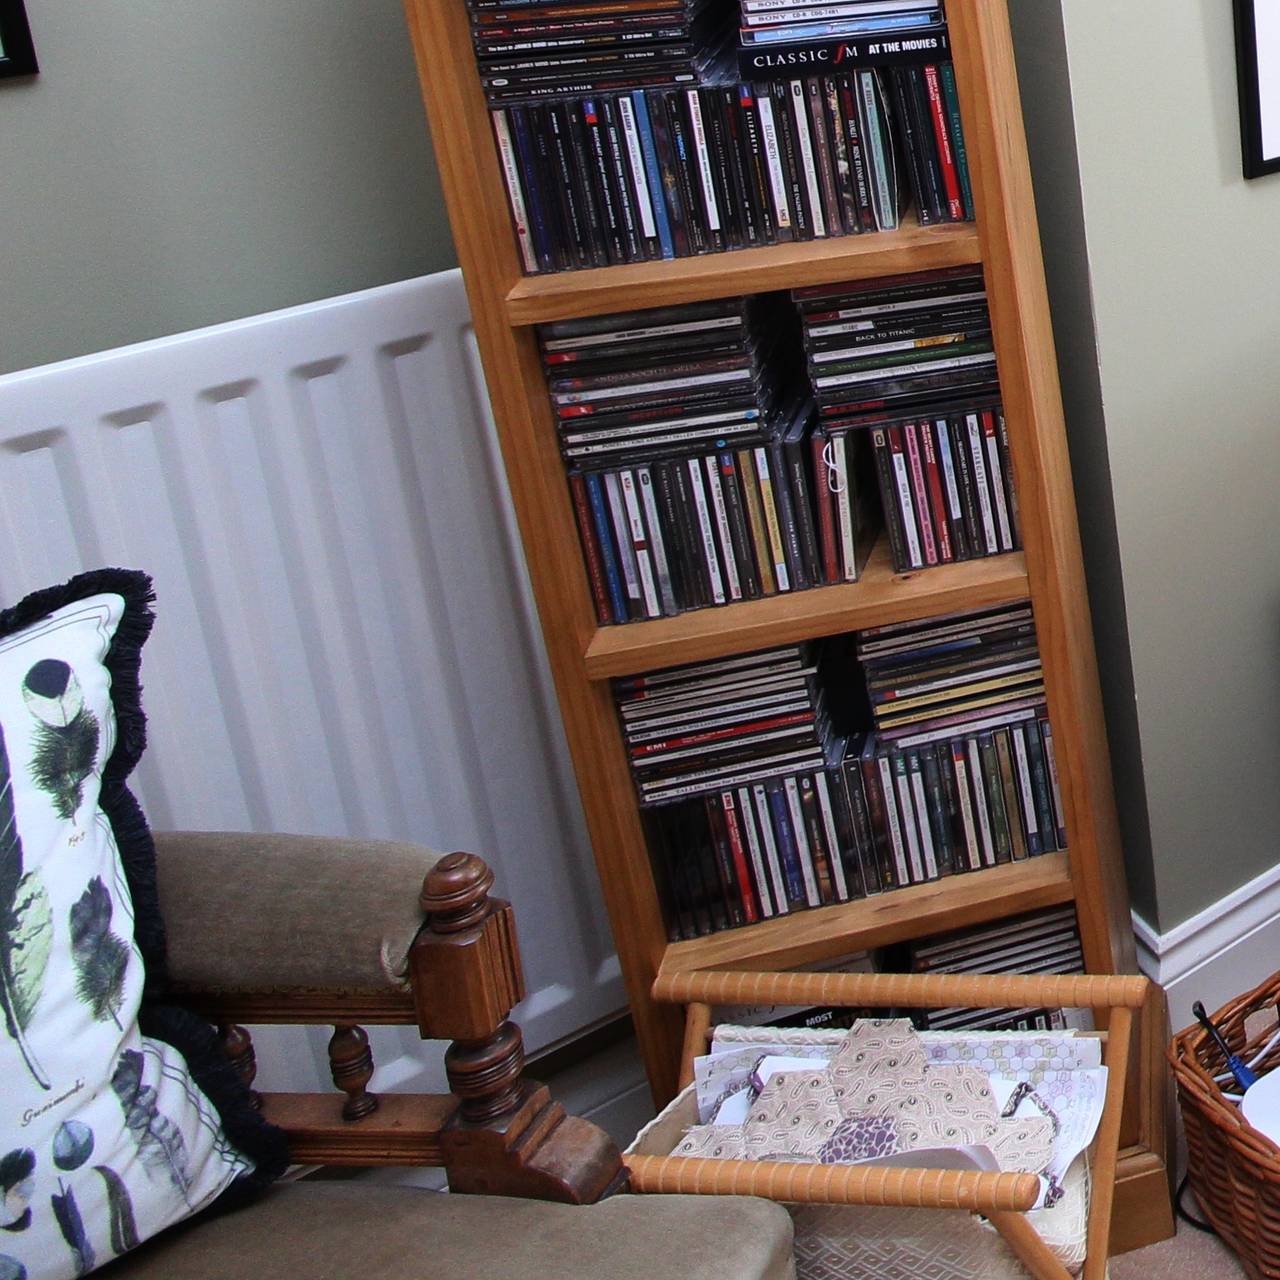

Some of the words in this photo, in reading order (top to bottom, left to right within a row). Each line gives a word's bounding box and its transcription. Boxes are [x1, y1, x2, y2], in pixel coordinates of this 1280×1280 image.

[752, 48, 828, 67] CLASSIC
[867, 43, 880, 54] AT
[882, 41, 901, 53] THE
[901, 37, 937, 51] MOVIES
[555, 84, 592, 92] ARTHUR
[621, 99, 629, 114] JOHN
[623, 114, 632, 130] BARRY
[848, 119, 857, 138] HAMLET
[591, 125, 602, 156] BRAVEHEART
[608, 126, 616, 143] CASINO
[746, 111, 758, 153] ELIZABETH
[765, 124, 776, 159] ELIZABETH
[852, 145, 860, 159] MUSIC
[597, 156, 605, 173] original
[600, 173, 608, 188] motion
[607, 204, 616, 228] soundtrack
[855, 333, 874, 341] BACK
[888, 328, 915, 337] TITANIC
[957, 440, 966, 468] SHAKESPEARE
[972, 446, 984, 484] STARGATE
[646, 742, 666, 751] EMI
[806, 1012, 833, 1026] MOST
